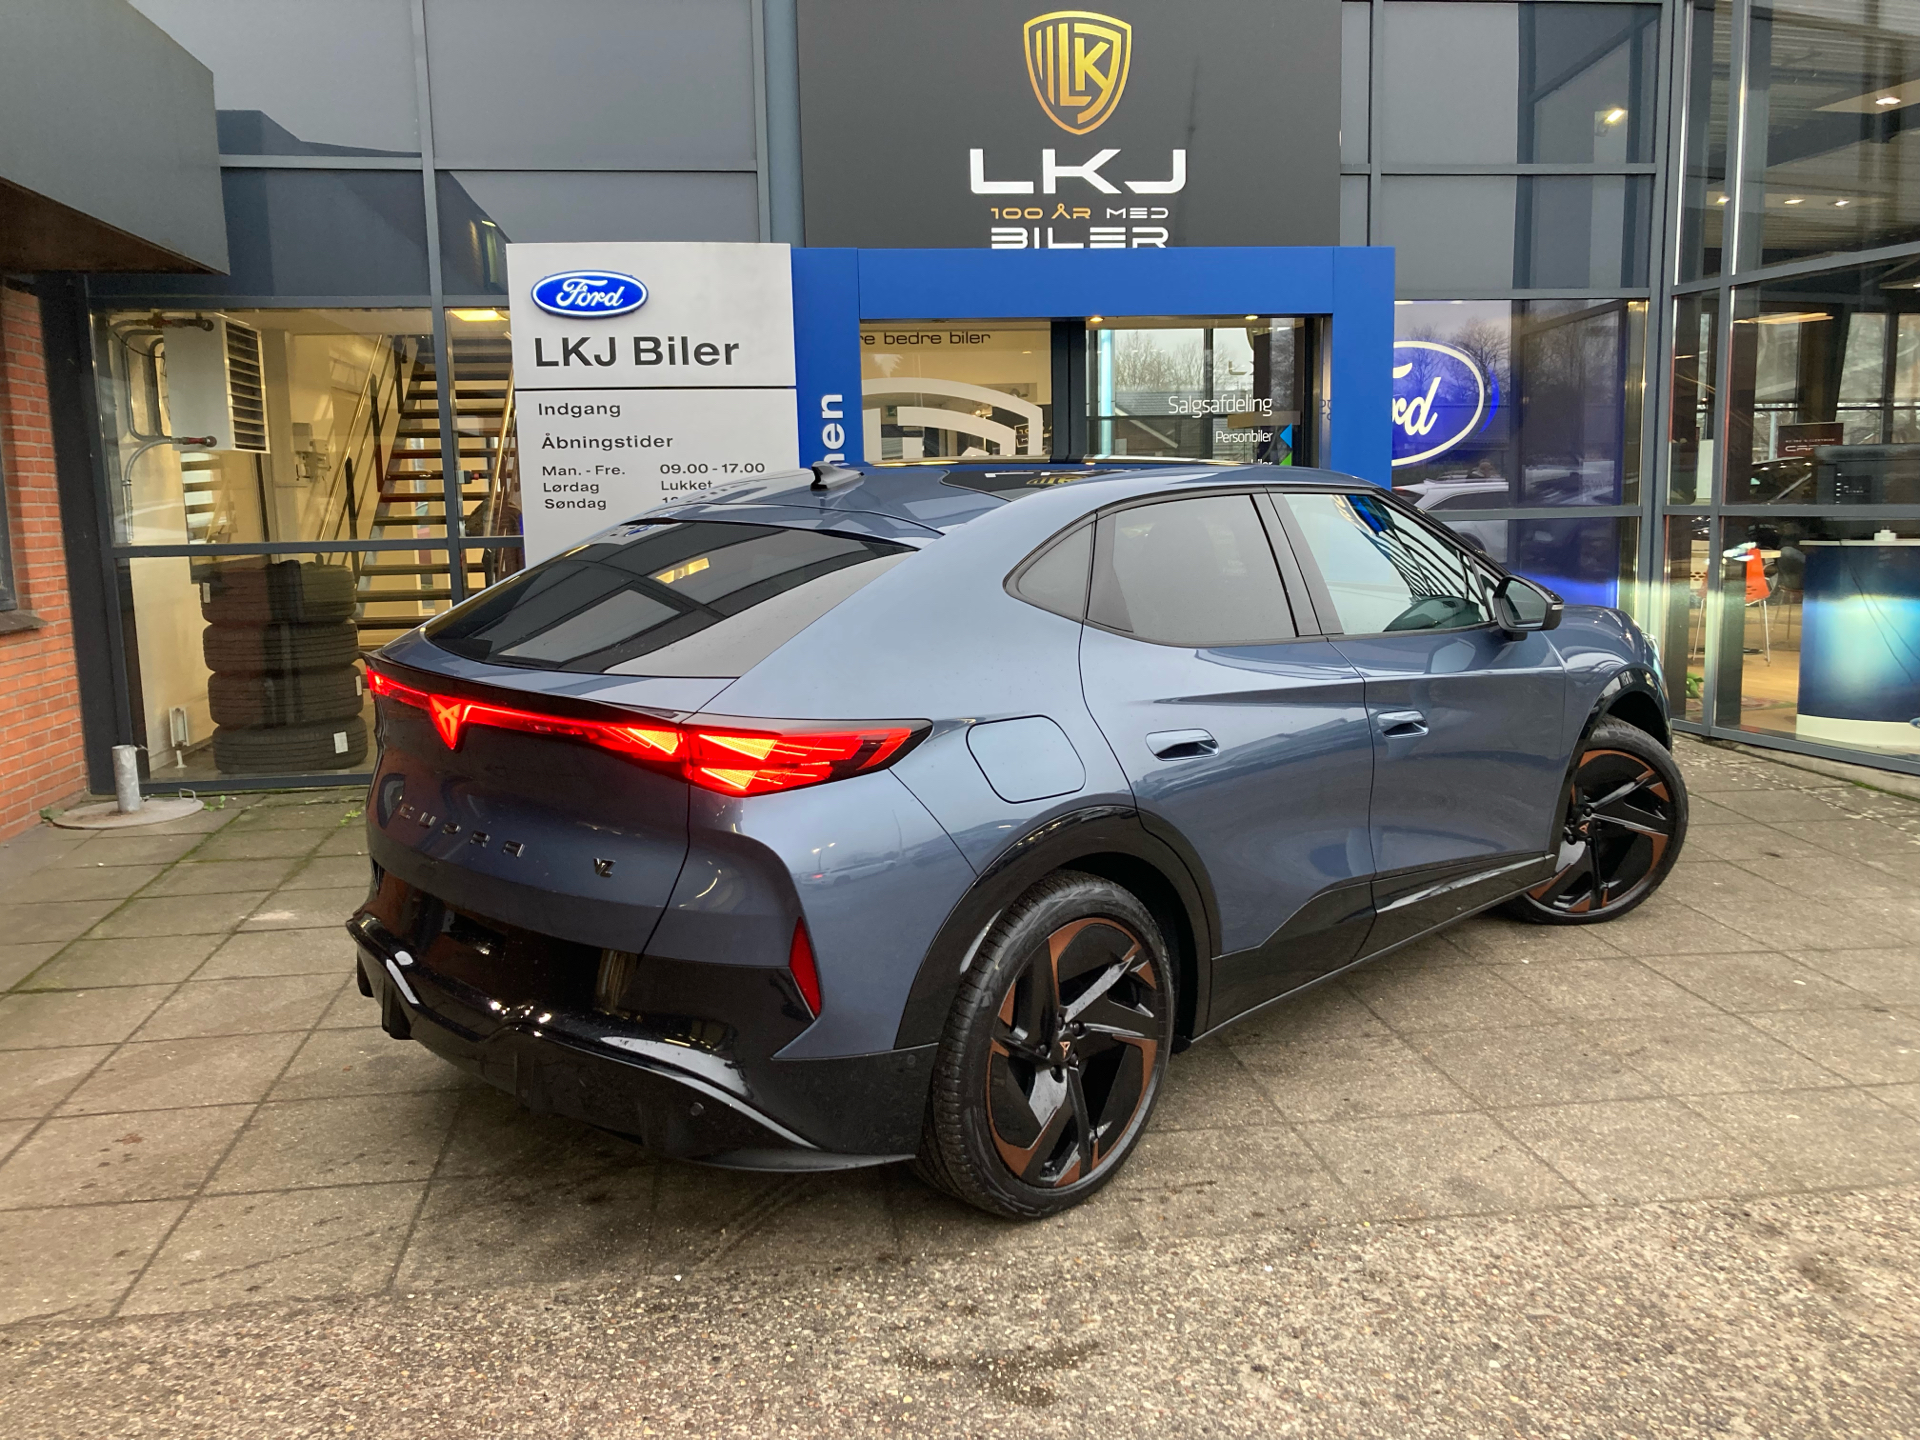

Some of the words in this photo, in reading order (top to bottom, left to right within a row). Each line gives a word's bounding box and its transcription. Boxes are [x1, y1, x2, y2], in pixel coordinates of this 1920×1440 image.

[970, 148, 1187, 195] LKJ
[990, 207, 1044, 219] 100
[1051, 203, 1091, 219] ÅR
[1106, 207, 1169, 219] MED
[990, 227, 1169, 249] BILER
[555, 278, 626, 307] Ford
[883, 332, 942, 345] bedre
[949, 331, 991, 344] biler
[534, 336, 617, 367] LKJ
[633, 336, 740, 366] Biler
[537, 402, 622, 418] Indgang
[1168, 394, 1273, 418] Salgsafdeling
[541, 433, 674, 451] Åbningstider
[1215, 430, 1274, 443] Personbiler
[542, 465, 582, 476] Man.
[594, 465, 626, 475] Fre.
[659, 463, 709, 475] 09.00
[721, 462, 766, 474] 17.00
[543, 481, 600, 495] Lørdag
[661, 480, 713, 491] Lukket
[544, 498, 608, 511] Søndag
[399, 803, 525, 858] CUPRA
[593, 857, 617, 878] VZ
